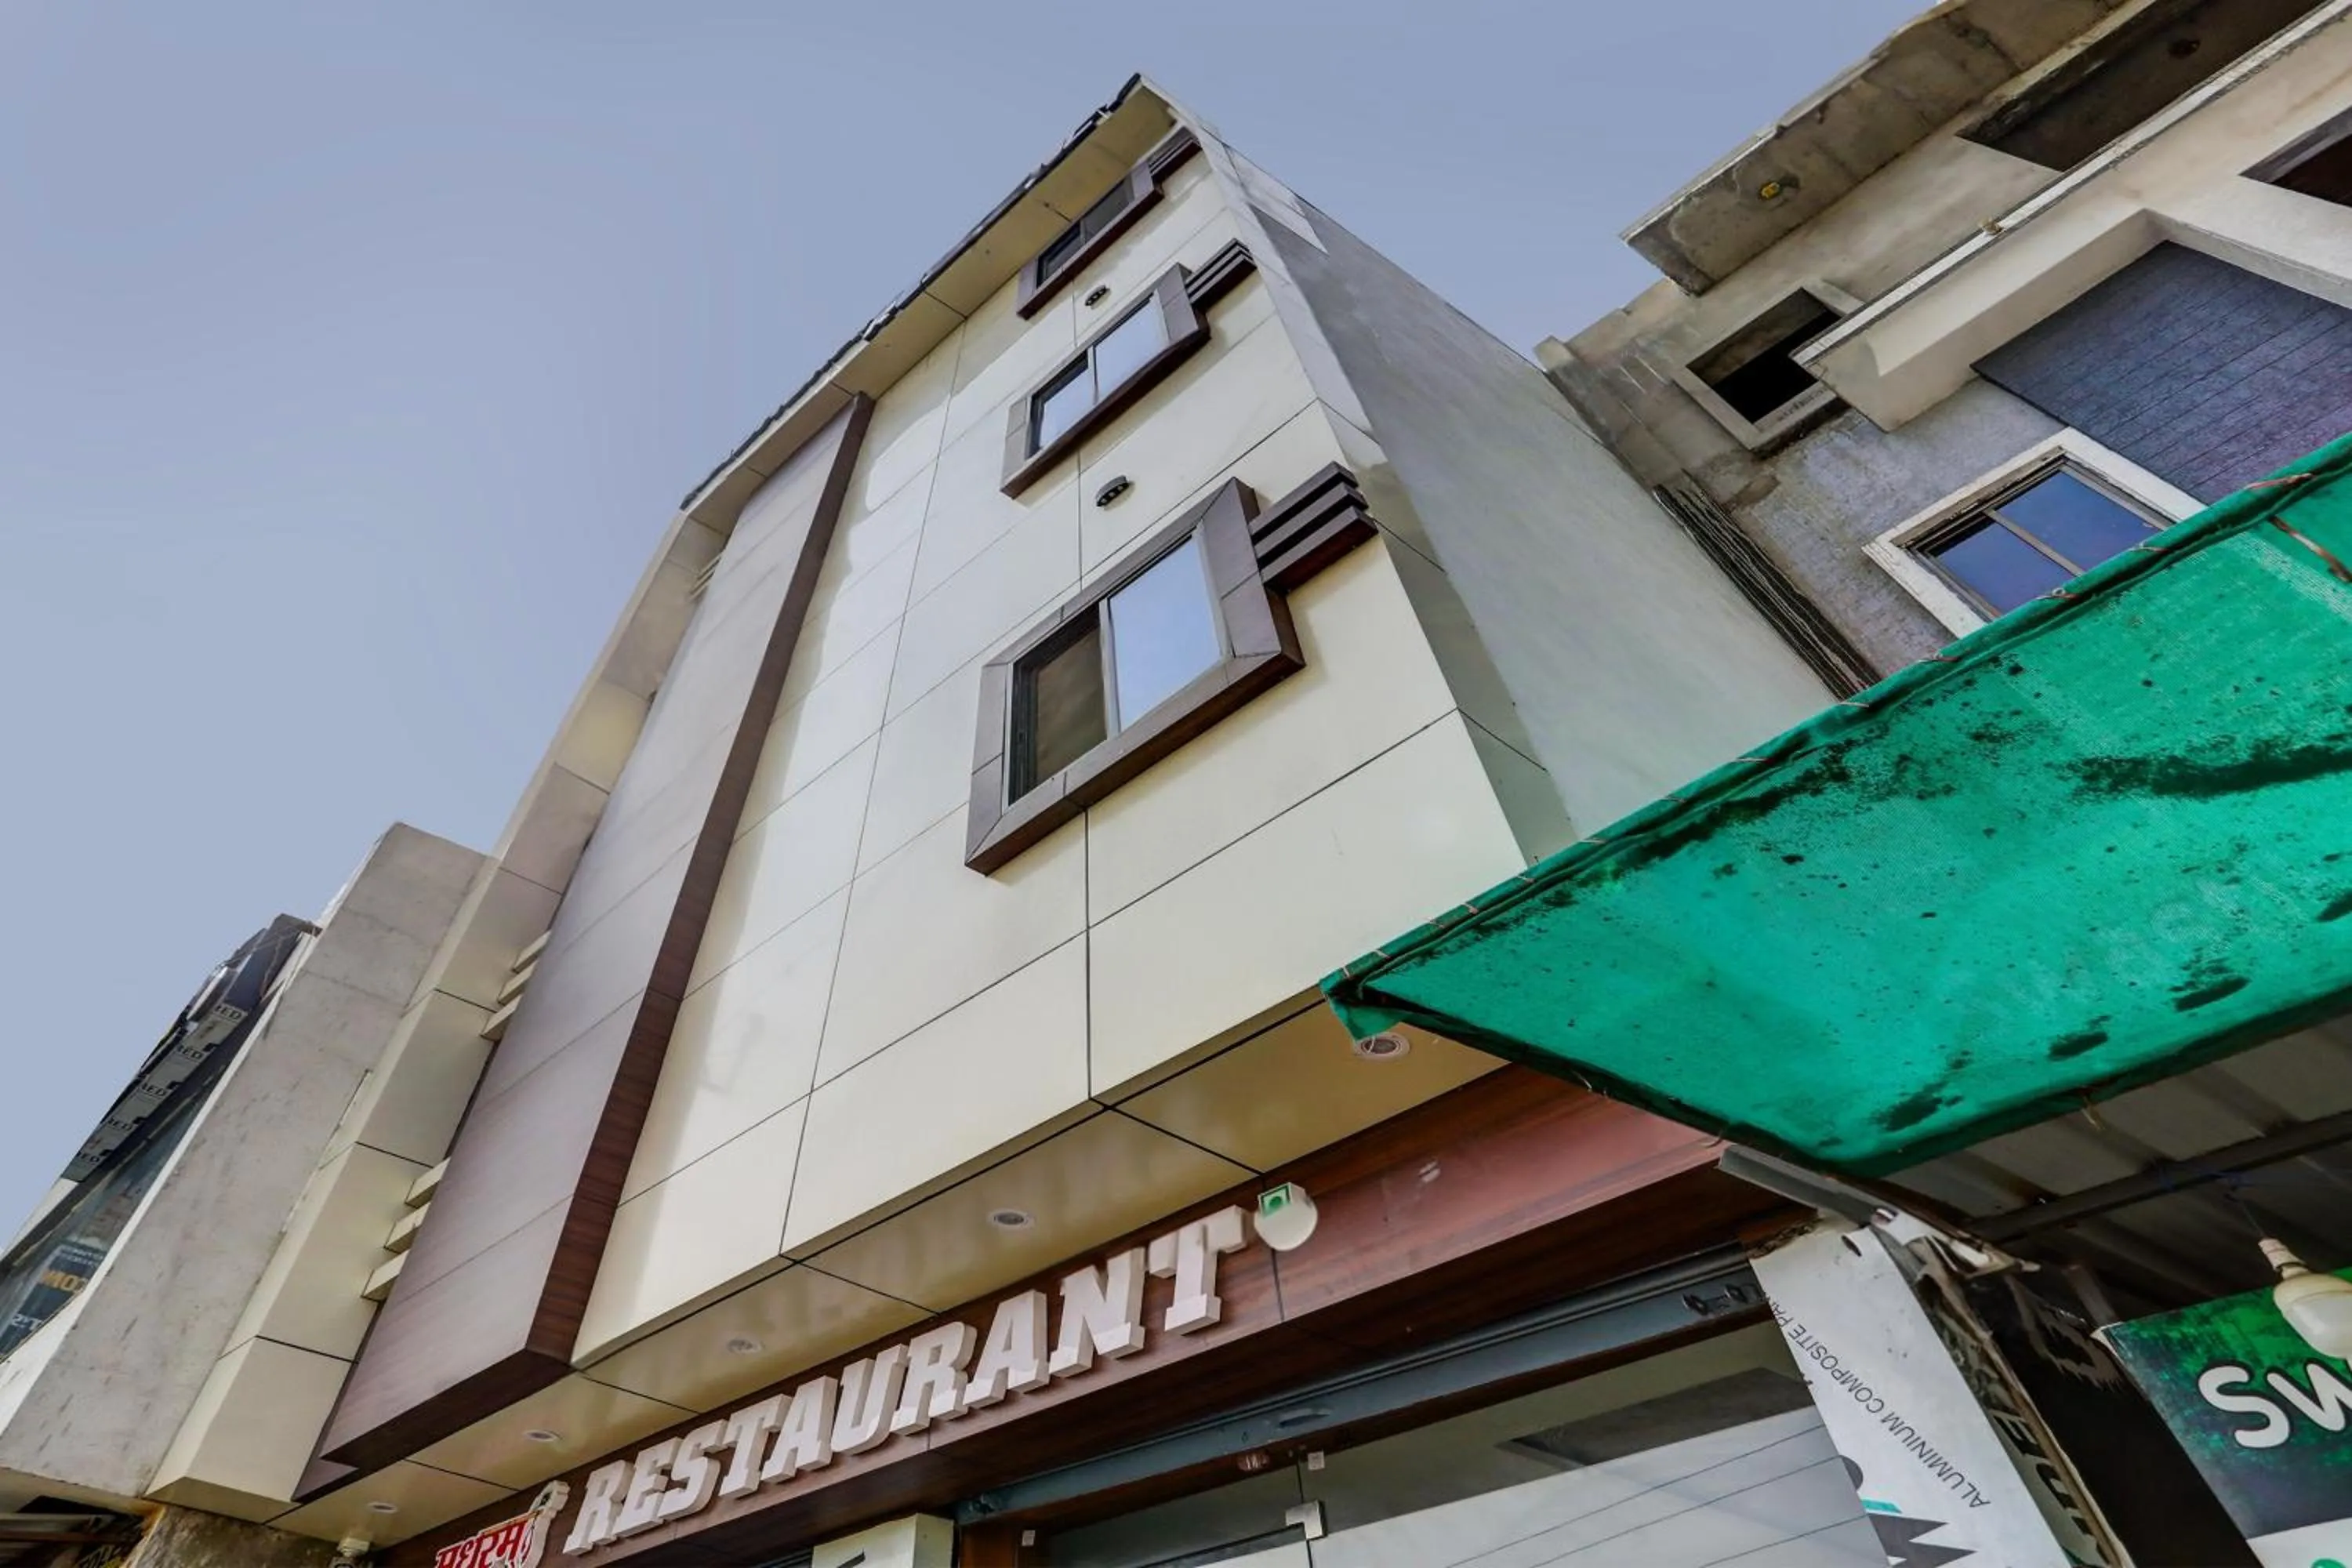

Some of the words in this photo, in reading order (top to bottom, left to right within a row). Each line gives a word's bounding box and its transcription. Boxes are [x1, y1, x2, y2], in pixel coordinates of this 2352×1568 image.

[562, 1205, 1247, 1555] RESTAURANT
[1787, 1323, 1885, 1414] COMPOSITE
[1881, 1411, 1991, 1508] ALUMINIUM
